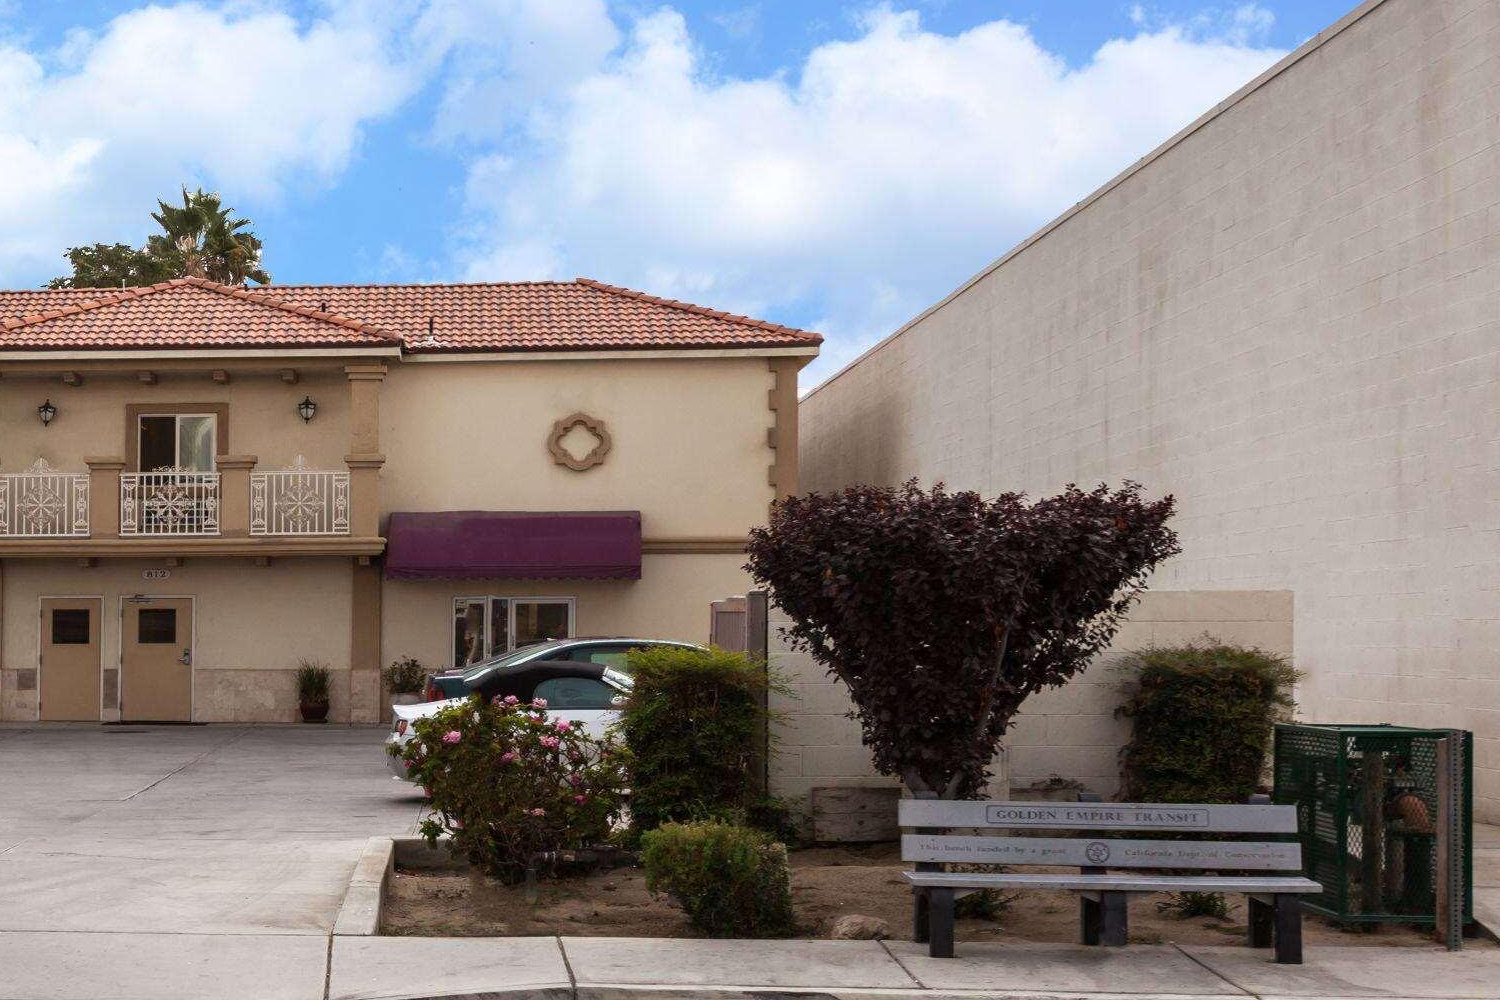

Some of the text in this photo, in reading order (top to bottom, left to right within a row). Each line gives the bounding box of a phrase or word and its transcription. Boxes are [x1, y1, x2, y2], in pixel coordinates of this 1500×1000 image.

[996, 810, 1198, 822] GOLDEN EMPIRE TRANSIT
